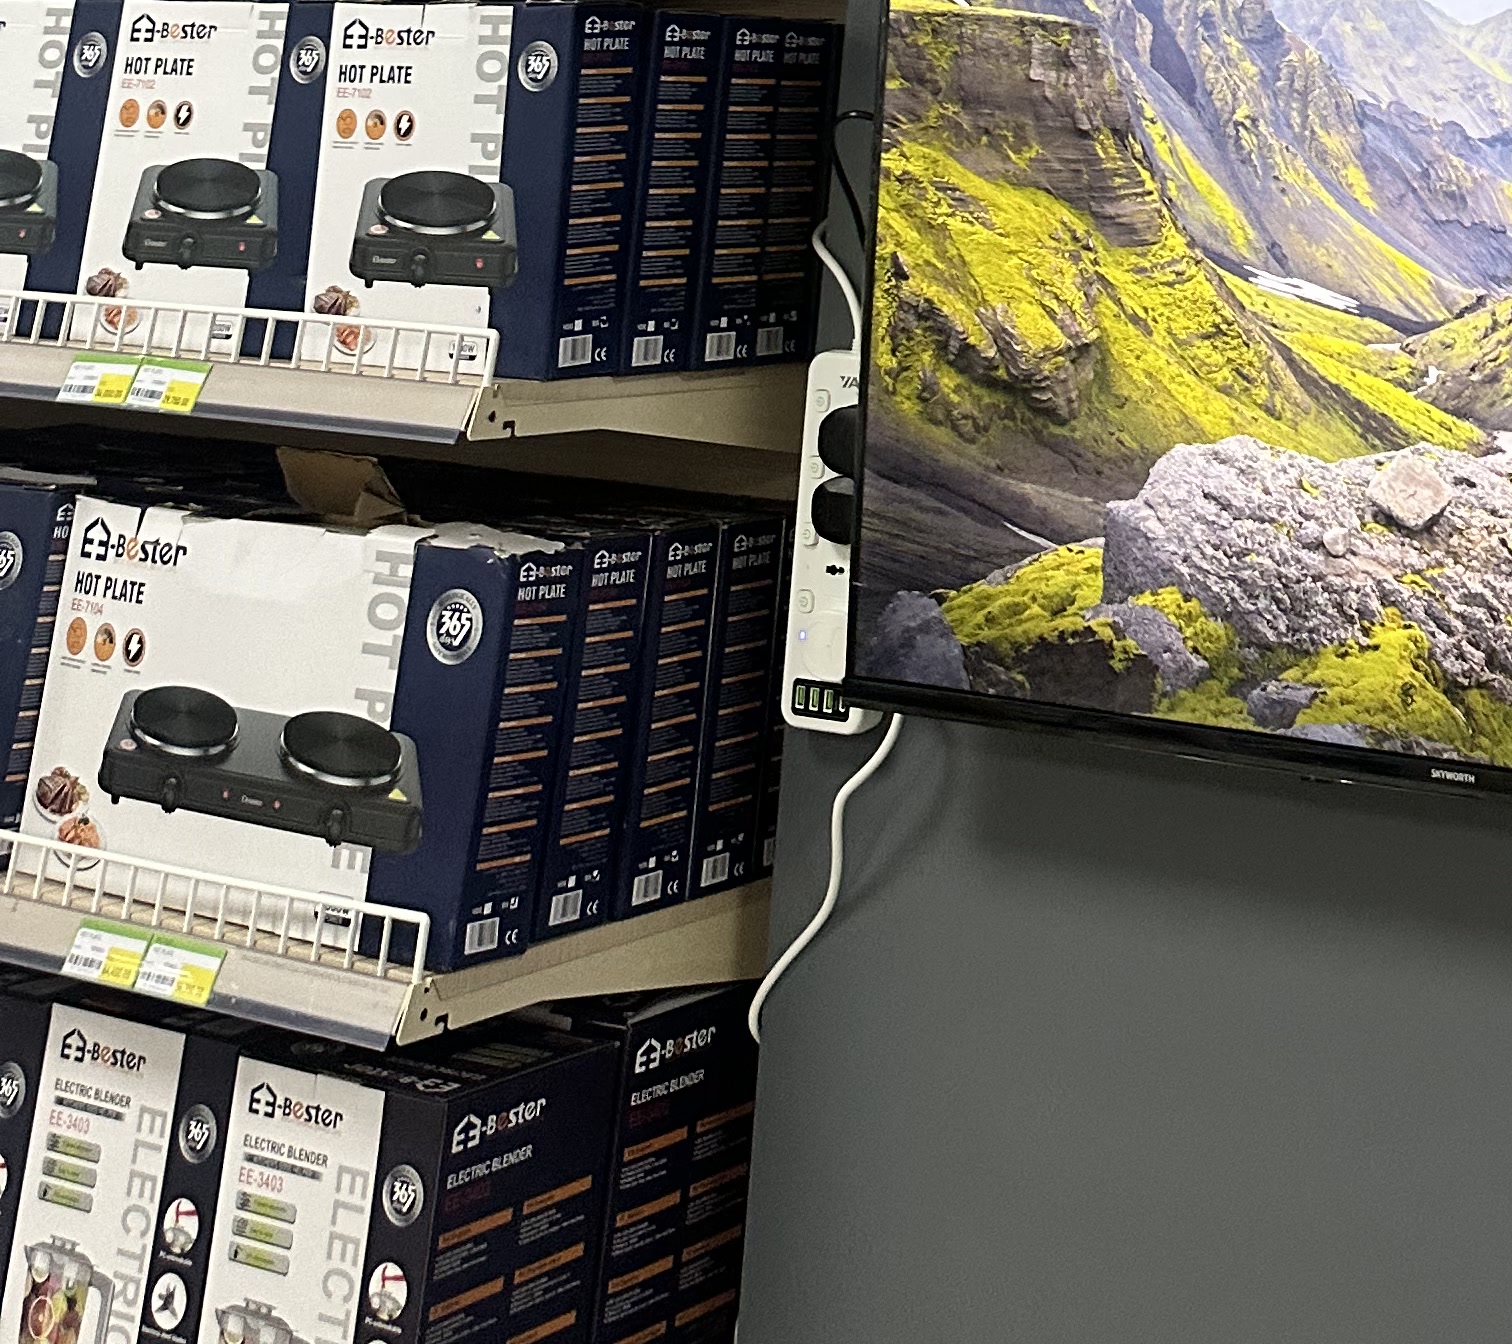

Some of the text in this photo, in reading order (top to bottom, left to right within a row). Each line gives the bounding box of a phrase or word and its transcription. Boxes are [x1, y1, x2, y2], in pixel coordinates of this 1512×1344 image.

[34, 7, 73, 98] HOT
[124, 57, 195, 76] HOT PLATE
[248, 10, 288, 105] HOT
[298, 49, 319, 72] 365
[473, 14, 512, 115] HOT
[526, 54, 550, 79] 365
[339, 64, 413, 84] HOT PLATE
[53, 526, 70, 539] HO
[74, 571, 146, 604] HOT PLATE
[518, 584, 566, 601] HOT PLATE
[591, 569, 636, 587] HOT PLATE
[362, 550, 415, 670] HOT
[439, 610, 473, 647] 365
[1430, 768, 1475, 784] SKYWORTH
[54, 1078, 132, 1109] ELECTRIC BLENDER
[187, 1118, 211, 1150] 365
[243, 1133, 329, 1168] ELECTRIC BLENDER
[446, 1144, 533, 1190] ELECTRIC BLENDER
[392, 1181, 417, 1212] 365
[314, 1164, 370, 1344] ELECT
